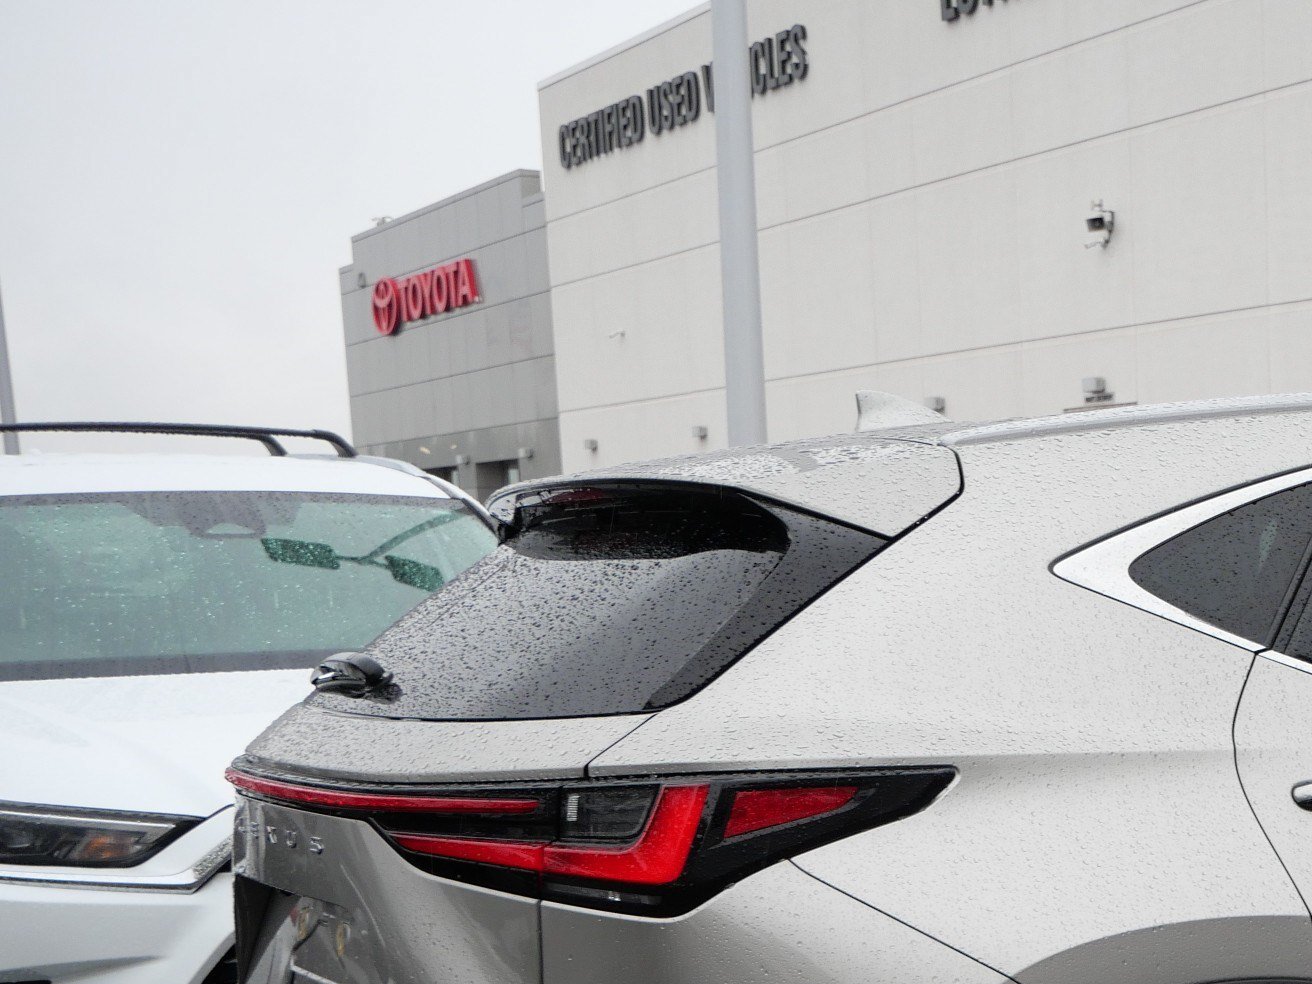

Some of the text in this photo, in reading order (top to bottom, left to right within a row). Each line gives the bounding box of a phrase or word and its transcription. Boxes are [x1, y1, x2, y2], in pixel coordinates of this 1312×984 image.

[558, 94, 645, 169] CERTIFIED
[646, 70, 700, 136] USED
[398, 258, 479, 323] TOYOTA
